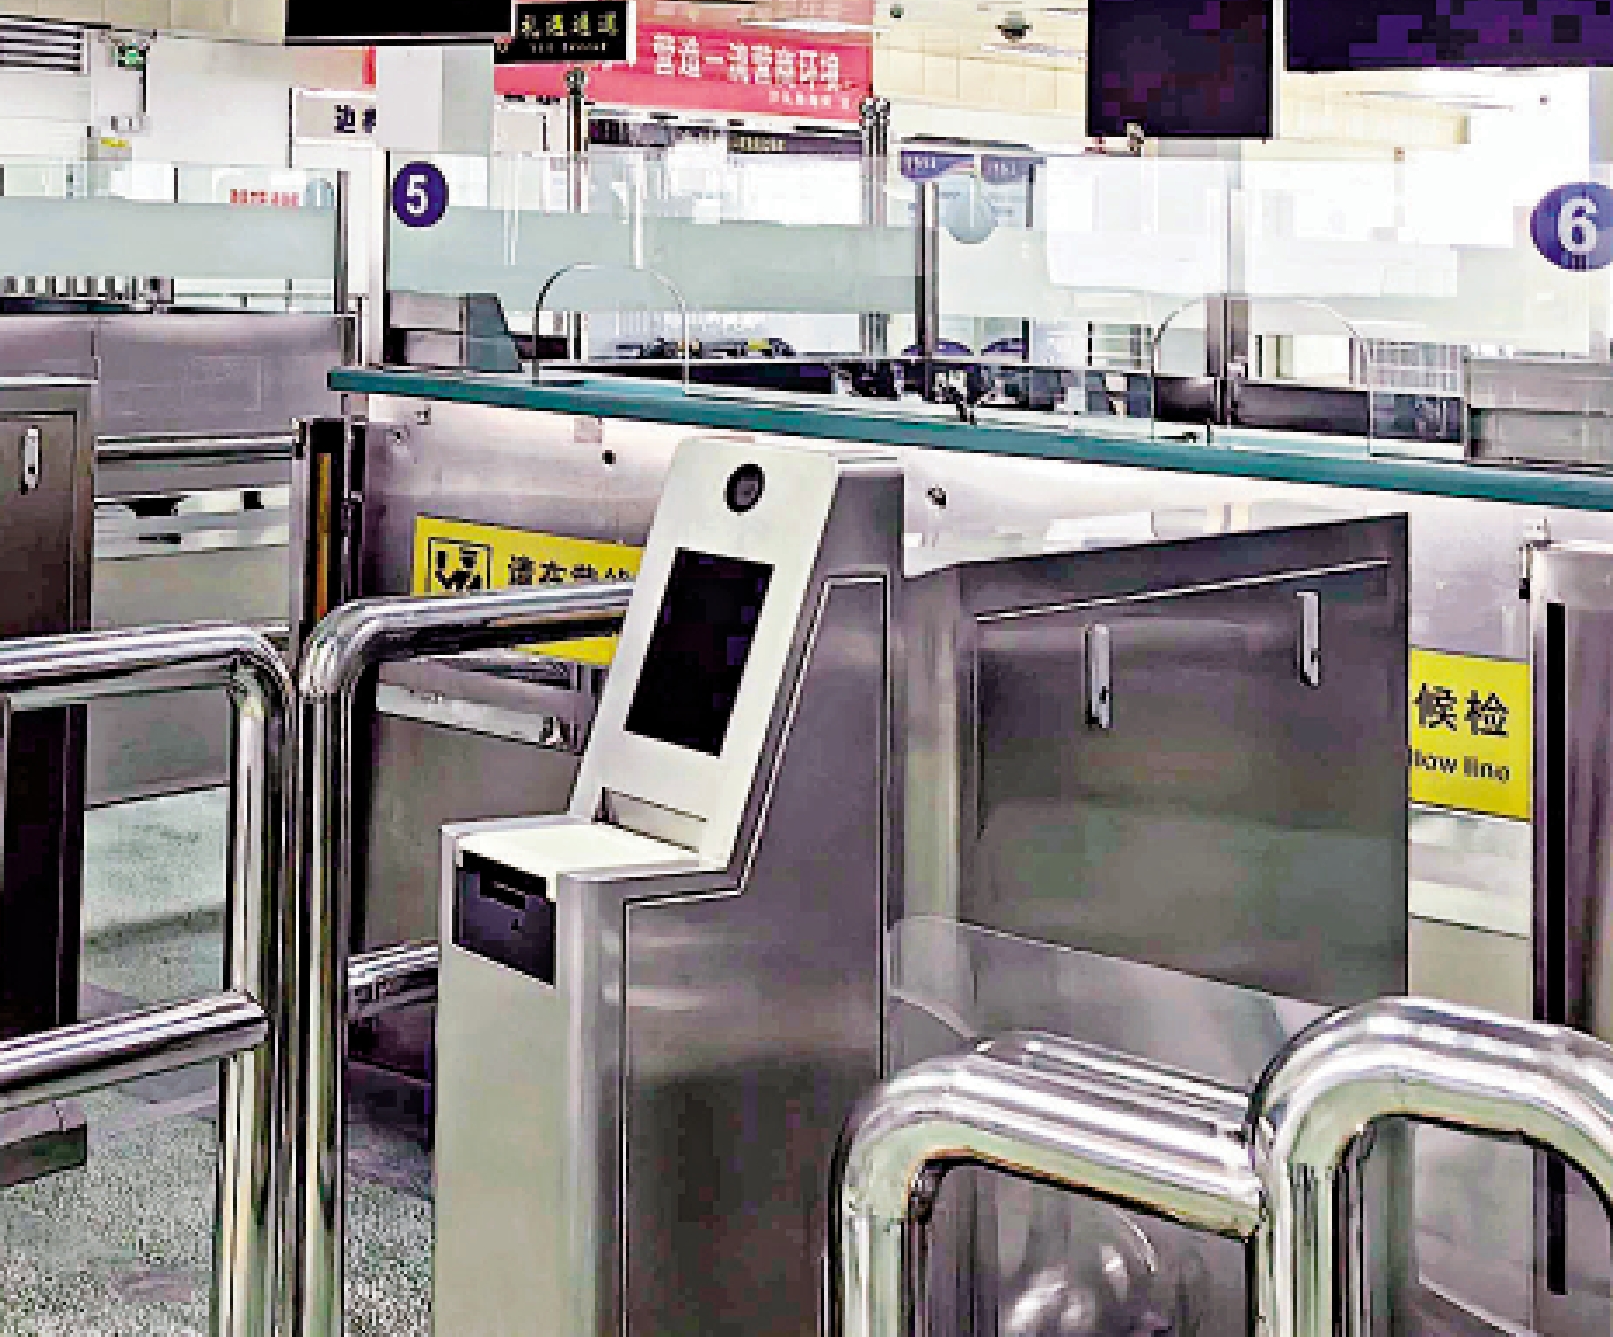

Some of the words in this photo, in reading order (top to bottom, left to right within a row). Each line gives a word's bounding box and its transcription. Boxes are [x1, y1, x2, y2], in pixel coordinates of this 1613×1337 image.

[407, 174, 429, 216] 5
[1557, 196, 1597, 254] 6
[1412, 682, 1509, 738] 候检
